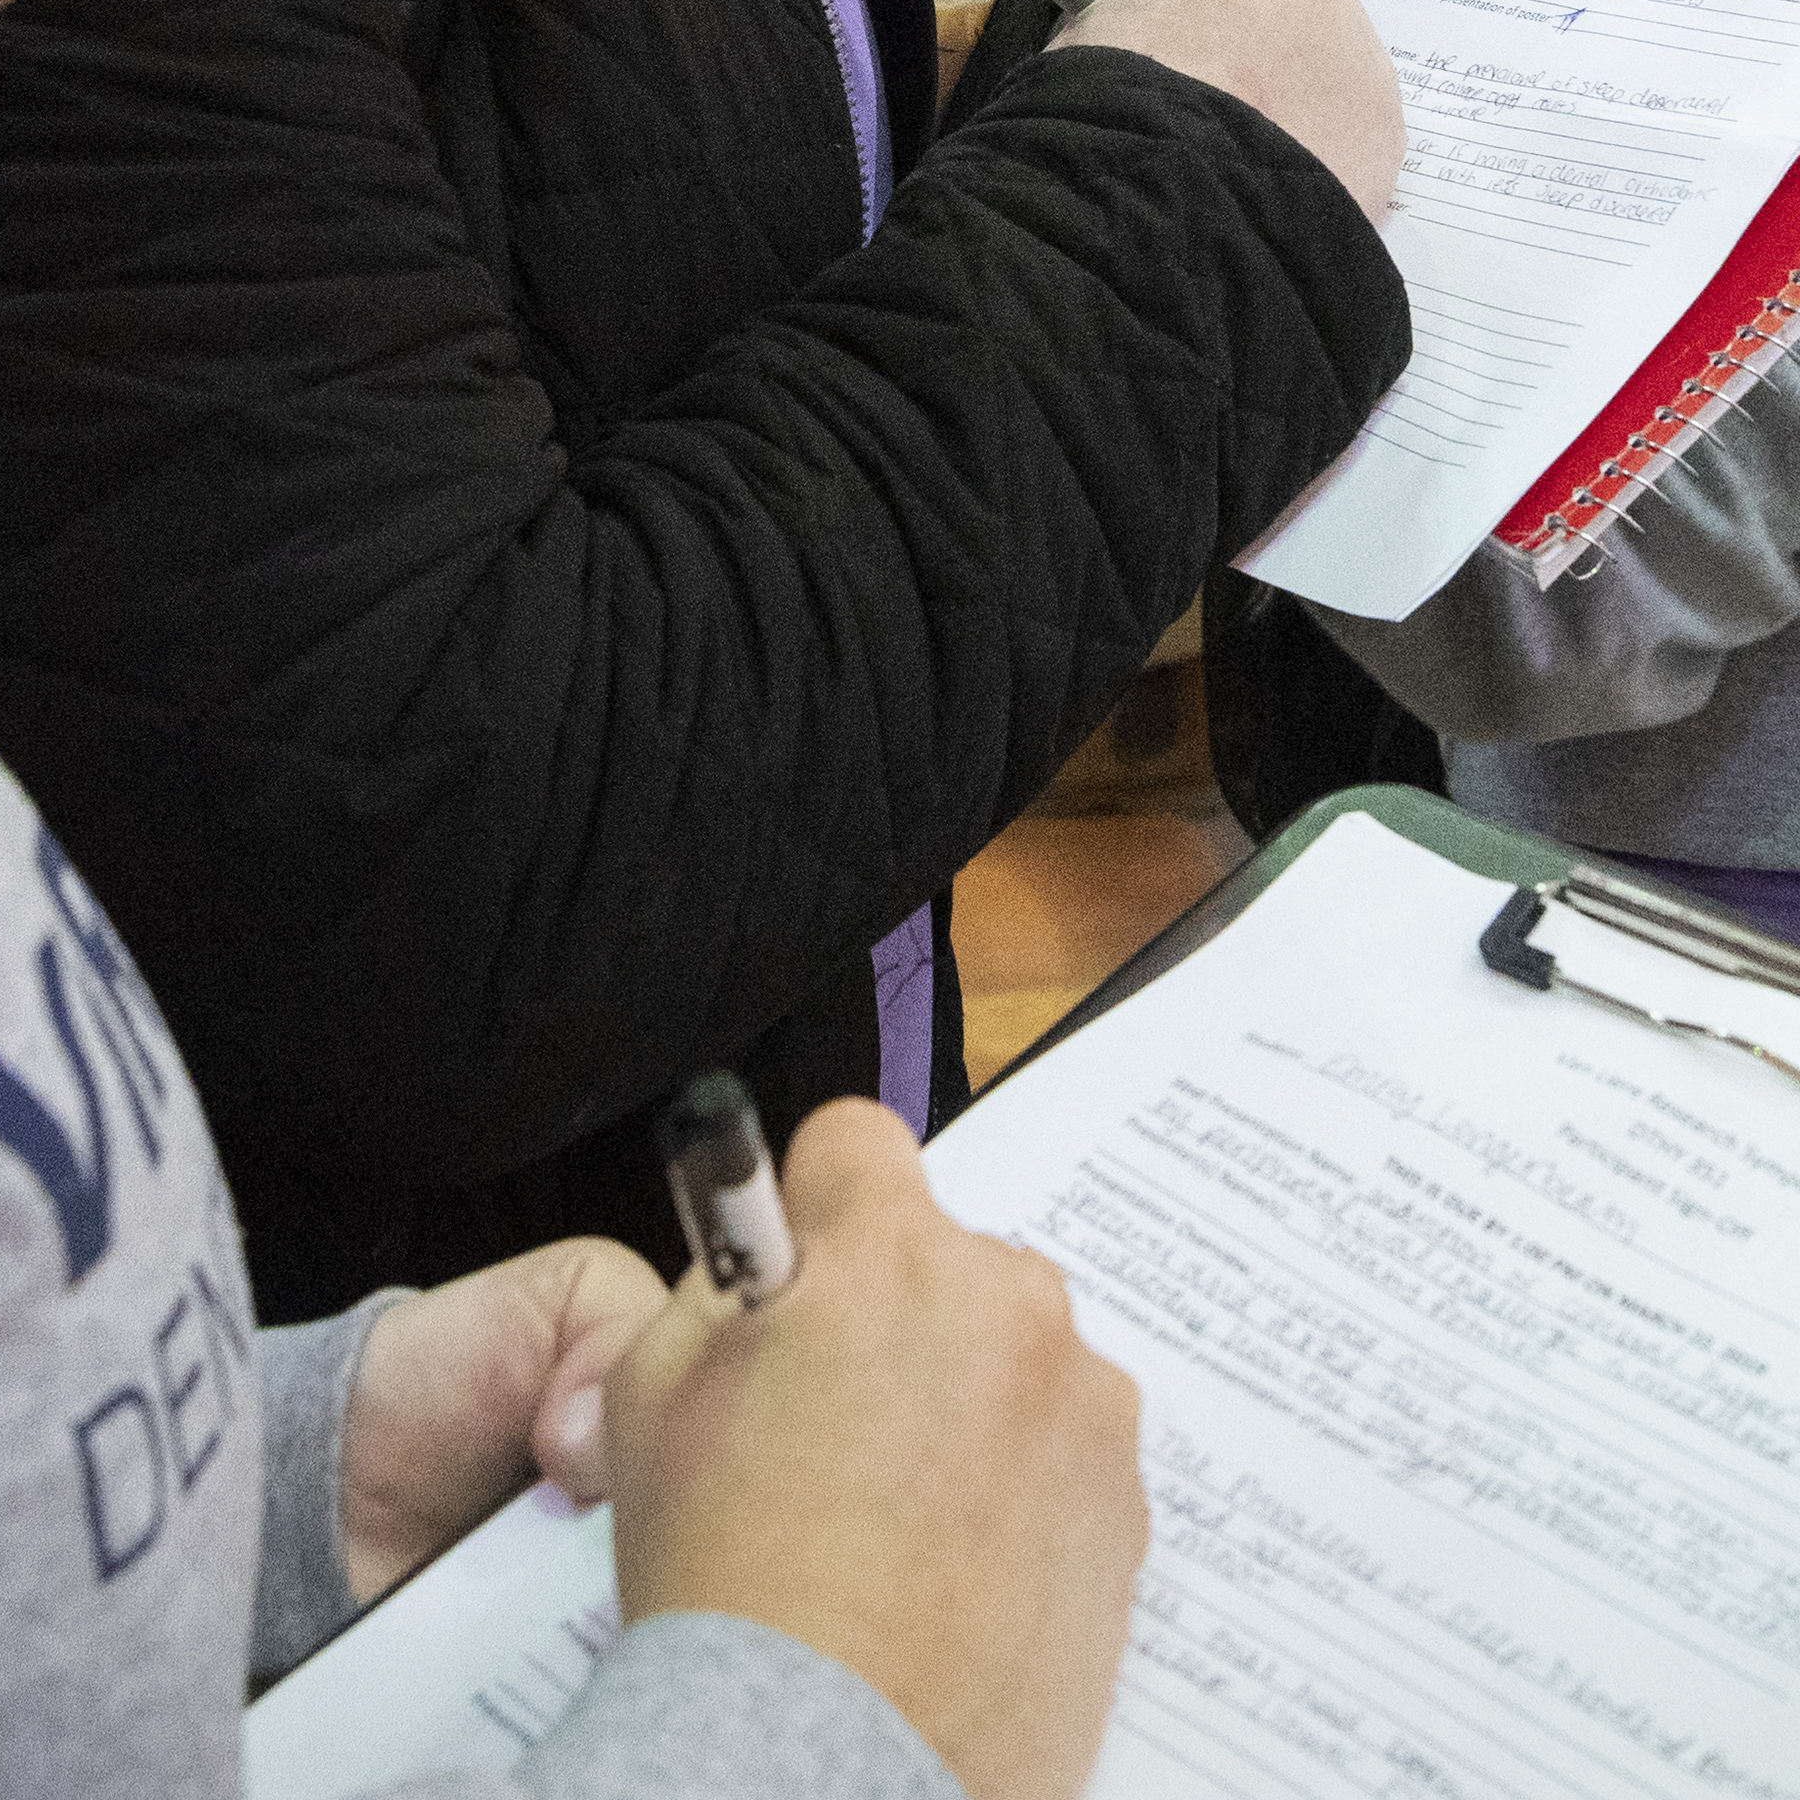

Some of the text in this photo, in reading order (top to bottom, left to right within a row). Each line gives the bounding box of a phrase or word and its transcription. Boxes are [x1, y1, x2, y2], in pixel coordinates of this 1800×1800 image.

[1506, 6, 1520, 16] of
[1517, 9, 1554, 26] poster:
[1641, 1087, 1743, 1156] Research
[1552, 1121, 1671, 1199] Participant
